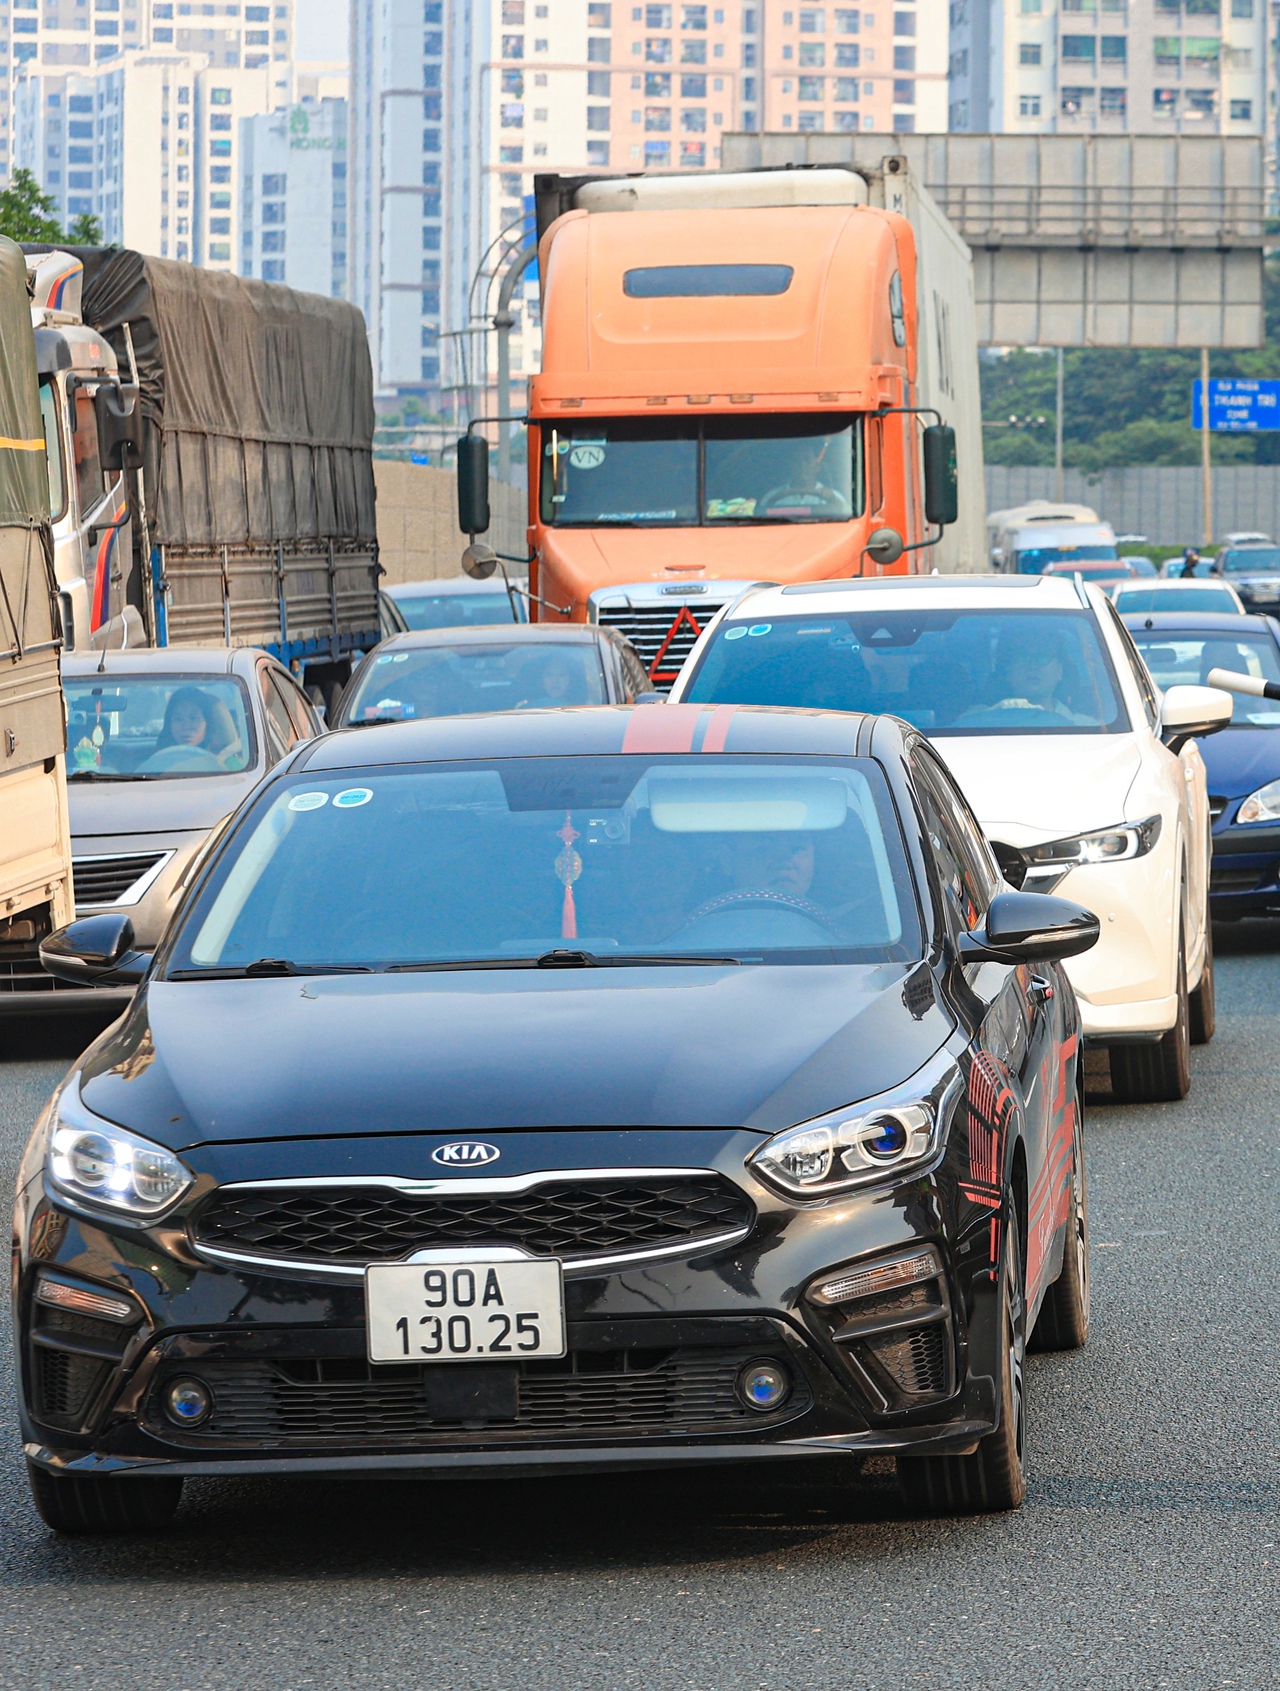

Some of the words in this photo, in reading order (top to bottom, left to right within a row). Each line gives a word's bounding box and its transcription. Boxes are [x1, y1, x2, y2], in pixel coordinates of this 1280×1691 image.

[574, 451, 601, 464] VN
[442, 1145, 489, 1161] KIA
[423, 1268, 504, 1307] 90A
[396, 1312, 541, 1354] 130.25
